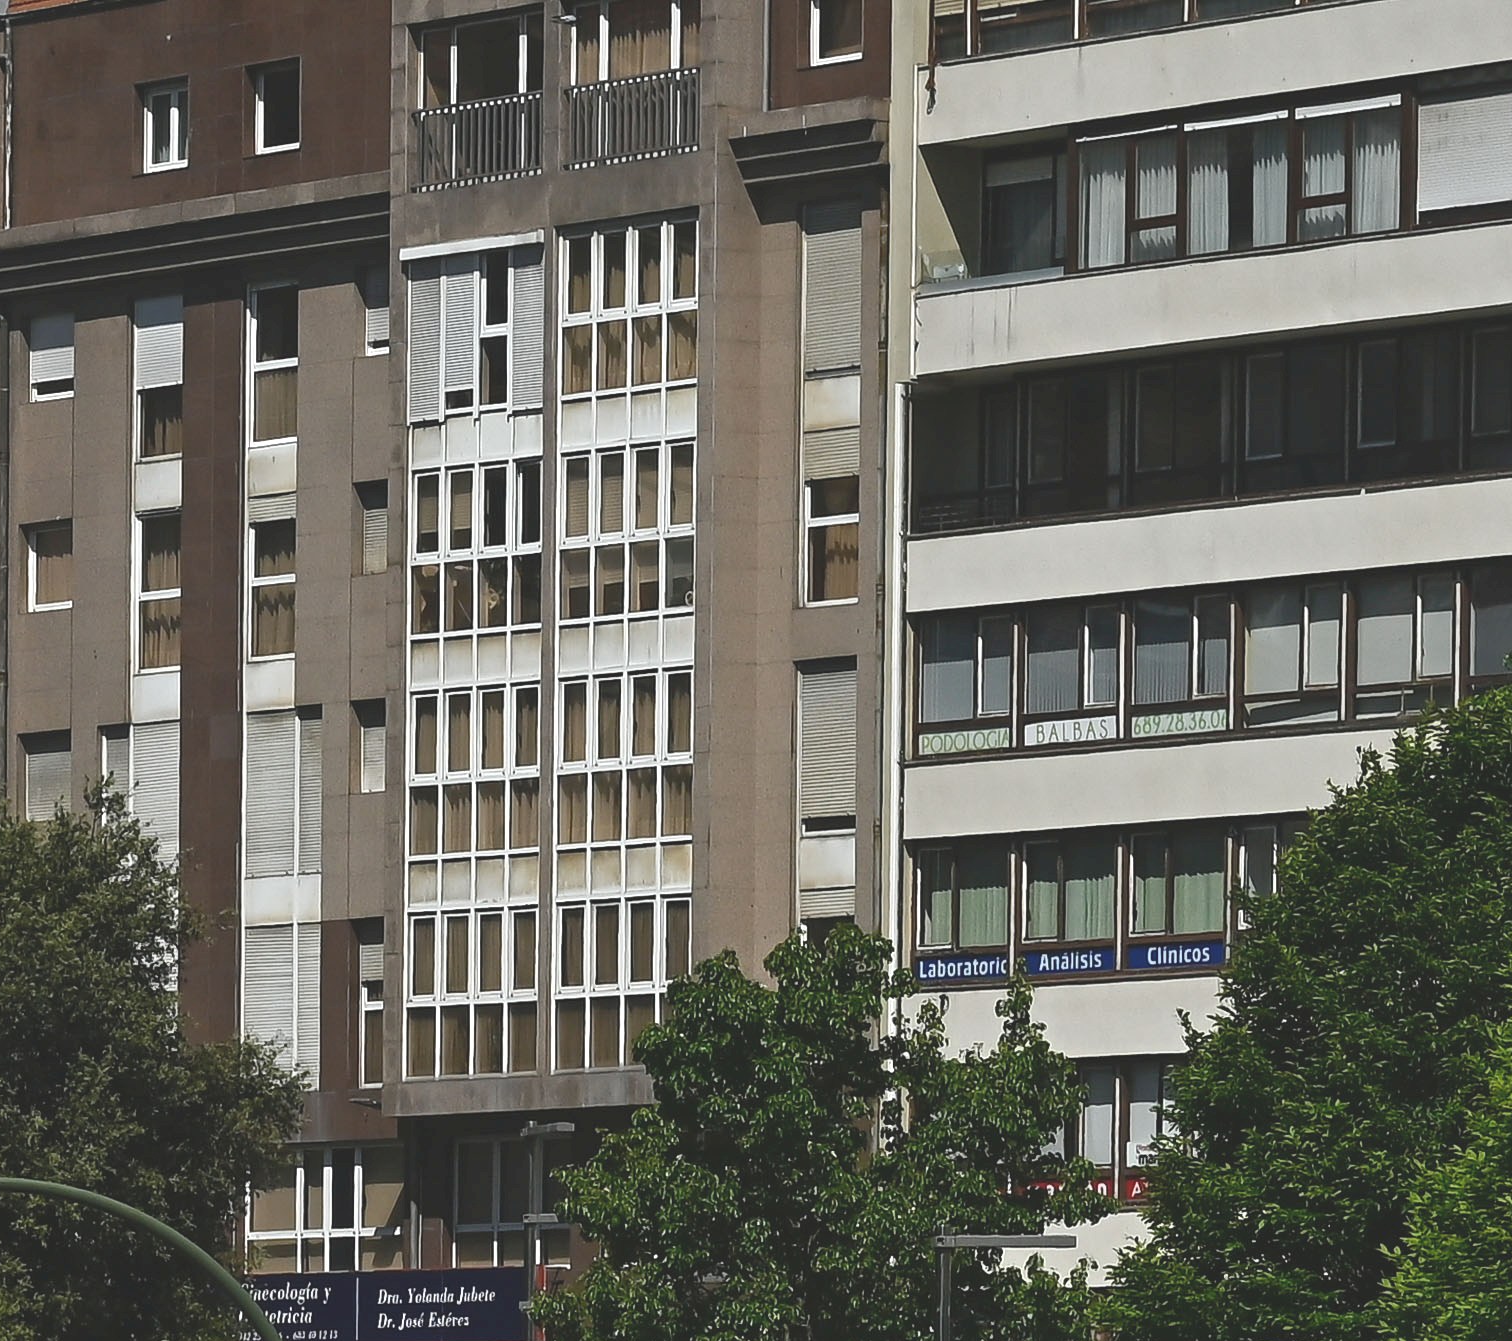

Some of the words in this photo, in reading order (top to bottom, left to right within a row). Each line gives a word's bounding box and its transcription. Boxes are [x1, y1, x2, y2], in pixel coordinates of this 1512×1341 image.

[1036, 719, 1109, 743] BALBAS
[1038, 948, 1102, 972] Análisis
[1146, 943, 1211, 966] Clínicos
[323, 1287, 331, 1304] y
[378, 1288, 403, 1304] Dra.
[408, 1287, 454, 1304] Yolanda
[456, 1286, 496, 1305] Jubete
[377, 1313, 396, 1328] Dr.
[398, 1313, 423, 1330] José
